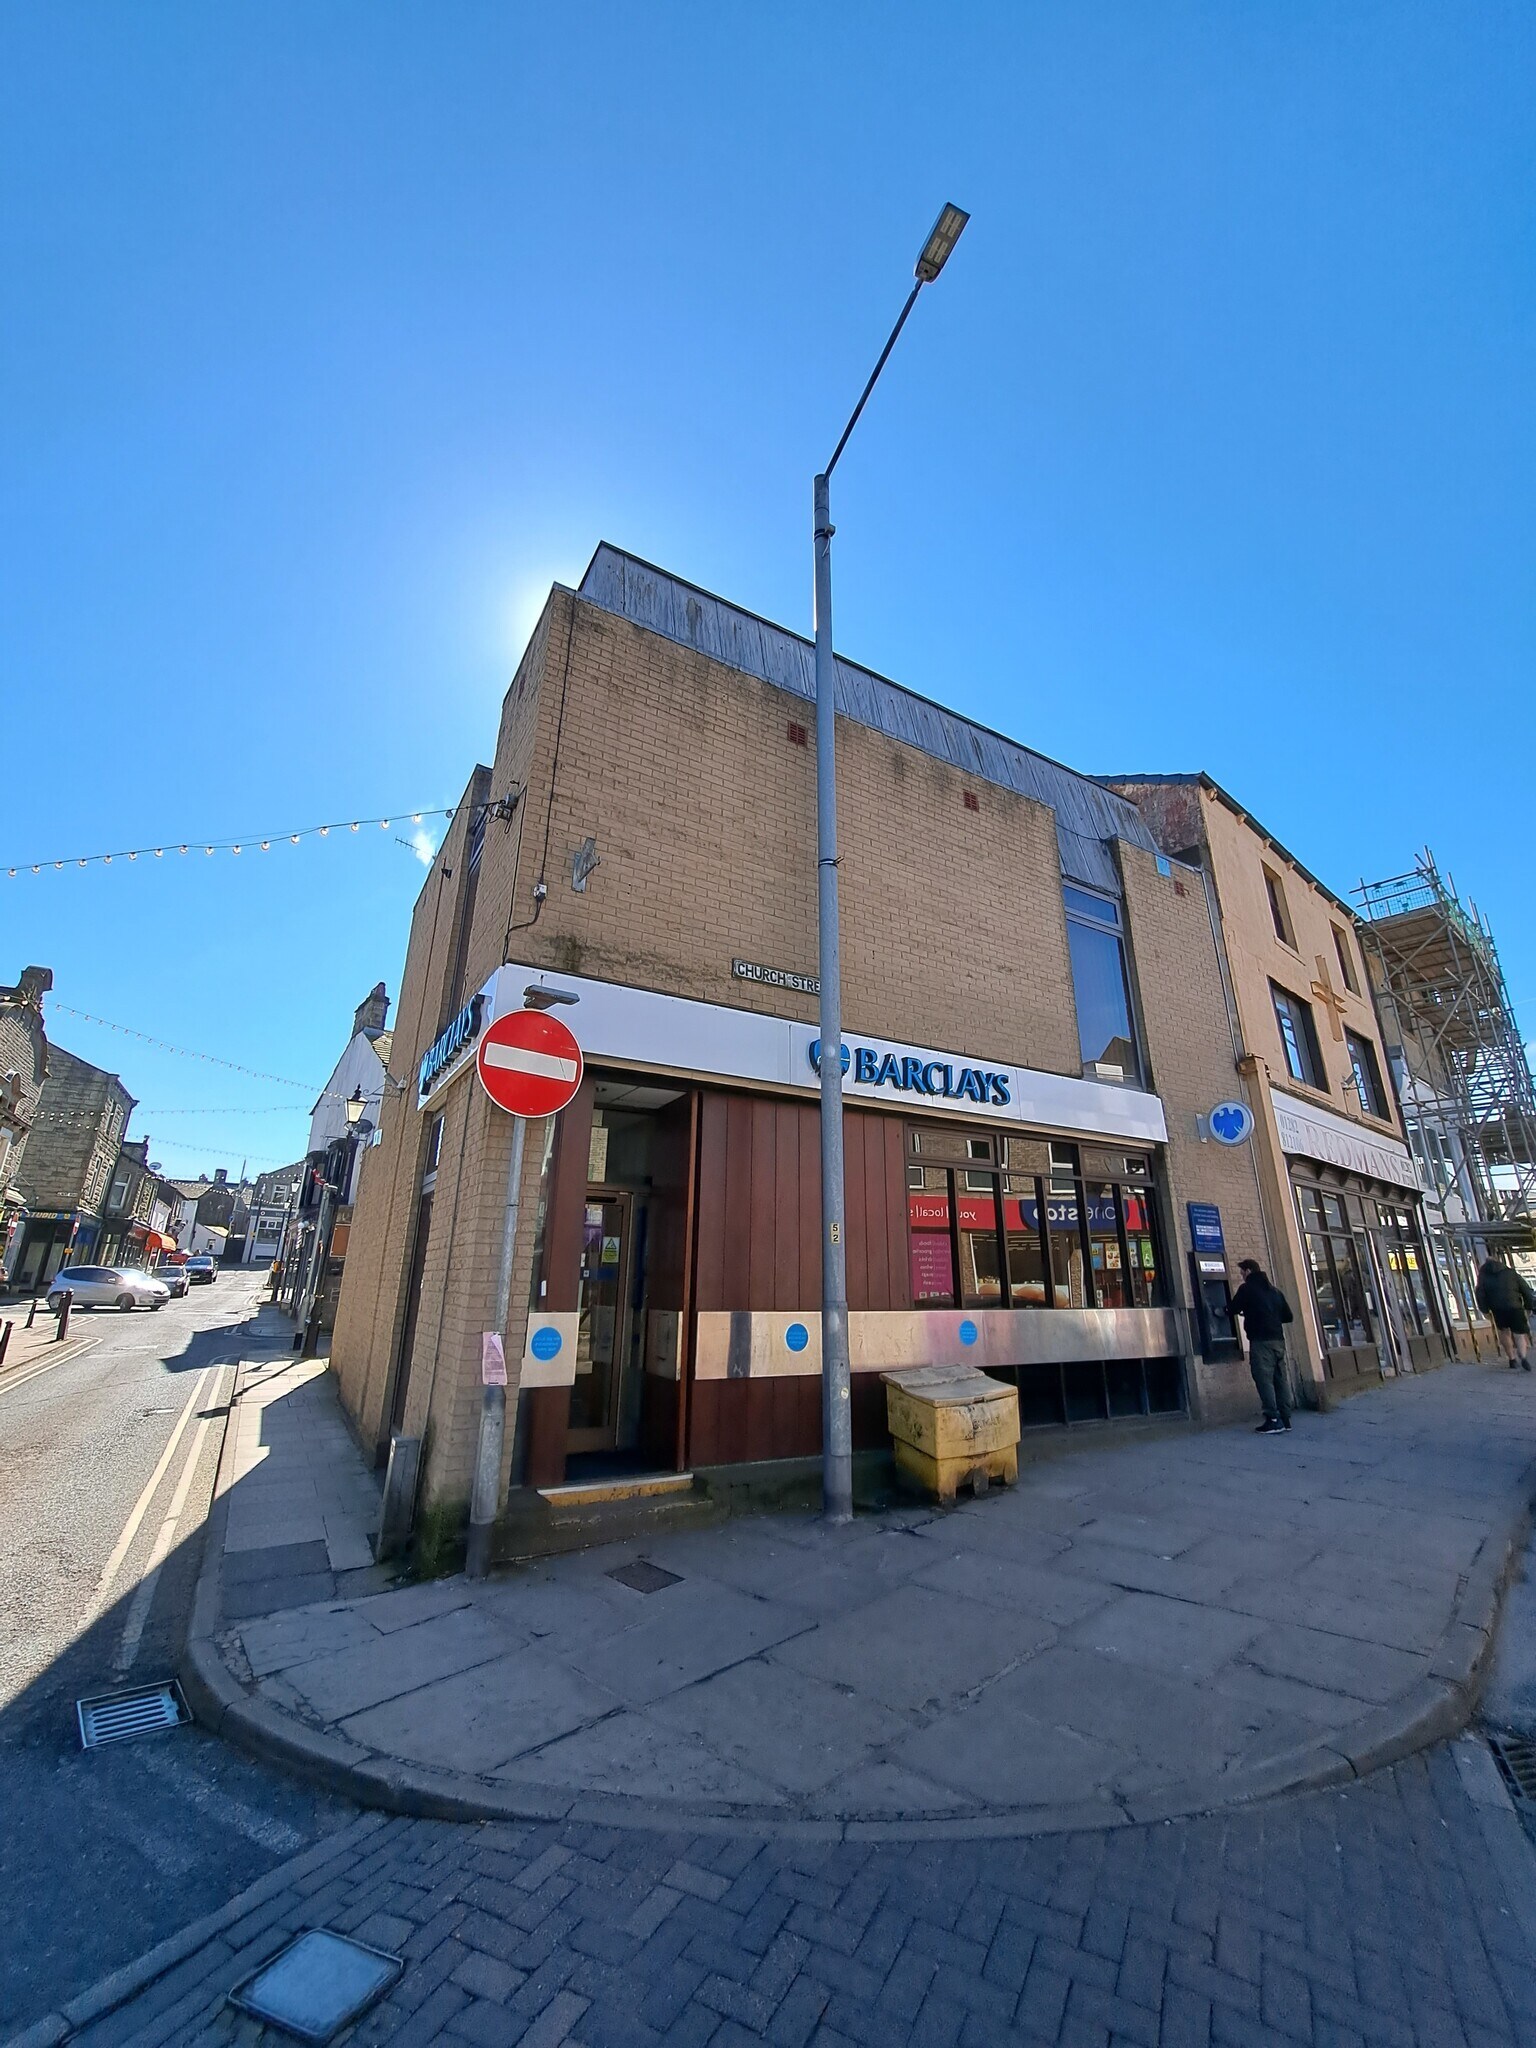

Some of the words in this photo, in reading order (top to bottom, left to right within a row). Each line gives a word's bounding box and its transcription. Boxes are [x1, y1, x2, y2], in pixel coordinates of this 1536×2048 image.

[737, 963, 787, 985] CHURCH
[791, 976, 821, 993] STRE
[855, 1047, 1011, 1107] BARCLAYS
[1304, 1123, 1402, 1184] REDMANS
